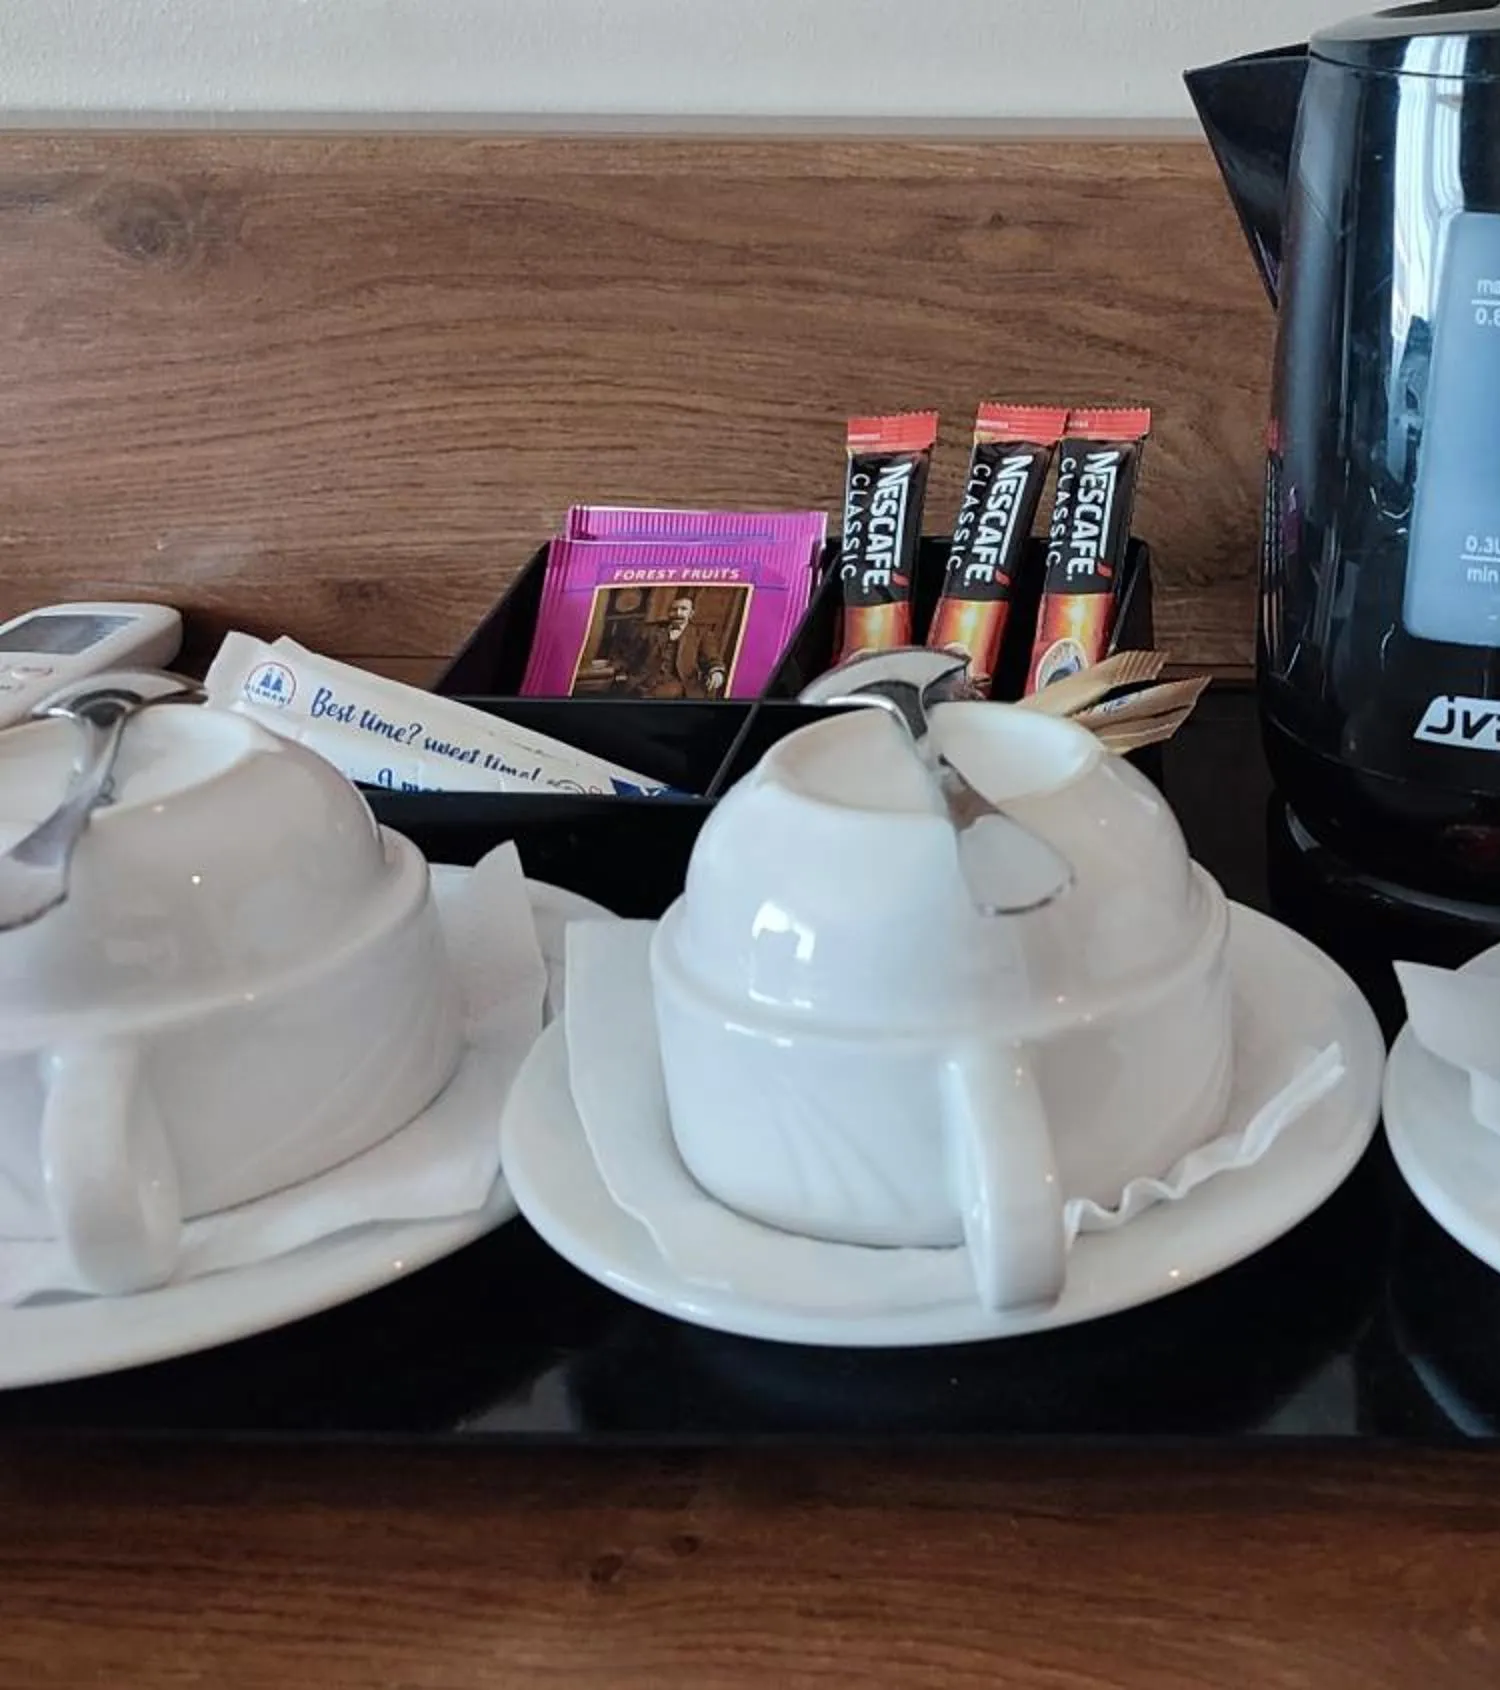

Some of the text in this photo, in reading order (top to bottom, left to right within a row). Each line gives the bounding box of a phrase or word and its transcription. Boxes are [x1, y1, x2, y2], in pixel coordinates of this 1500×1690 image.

[840, 472, 871, 582] CLASSIC
[946, 463, 992, 572] CLASSIC
[1045, 456, 1077, 568] CLASSIC
[613, 566, 742, 581] FOREST FRUITS
[1465, 563, 1500, 584] min
[310, 686, 357, 724] Best
[359, 708, 423, 746] time?
[424, 736, 481, 766] sweet
